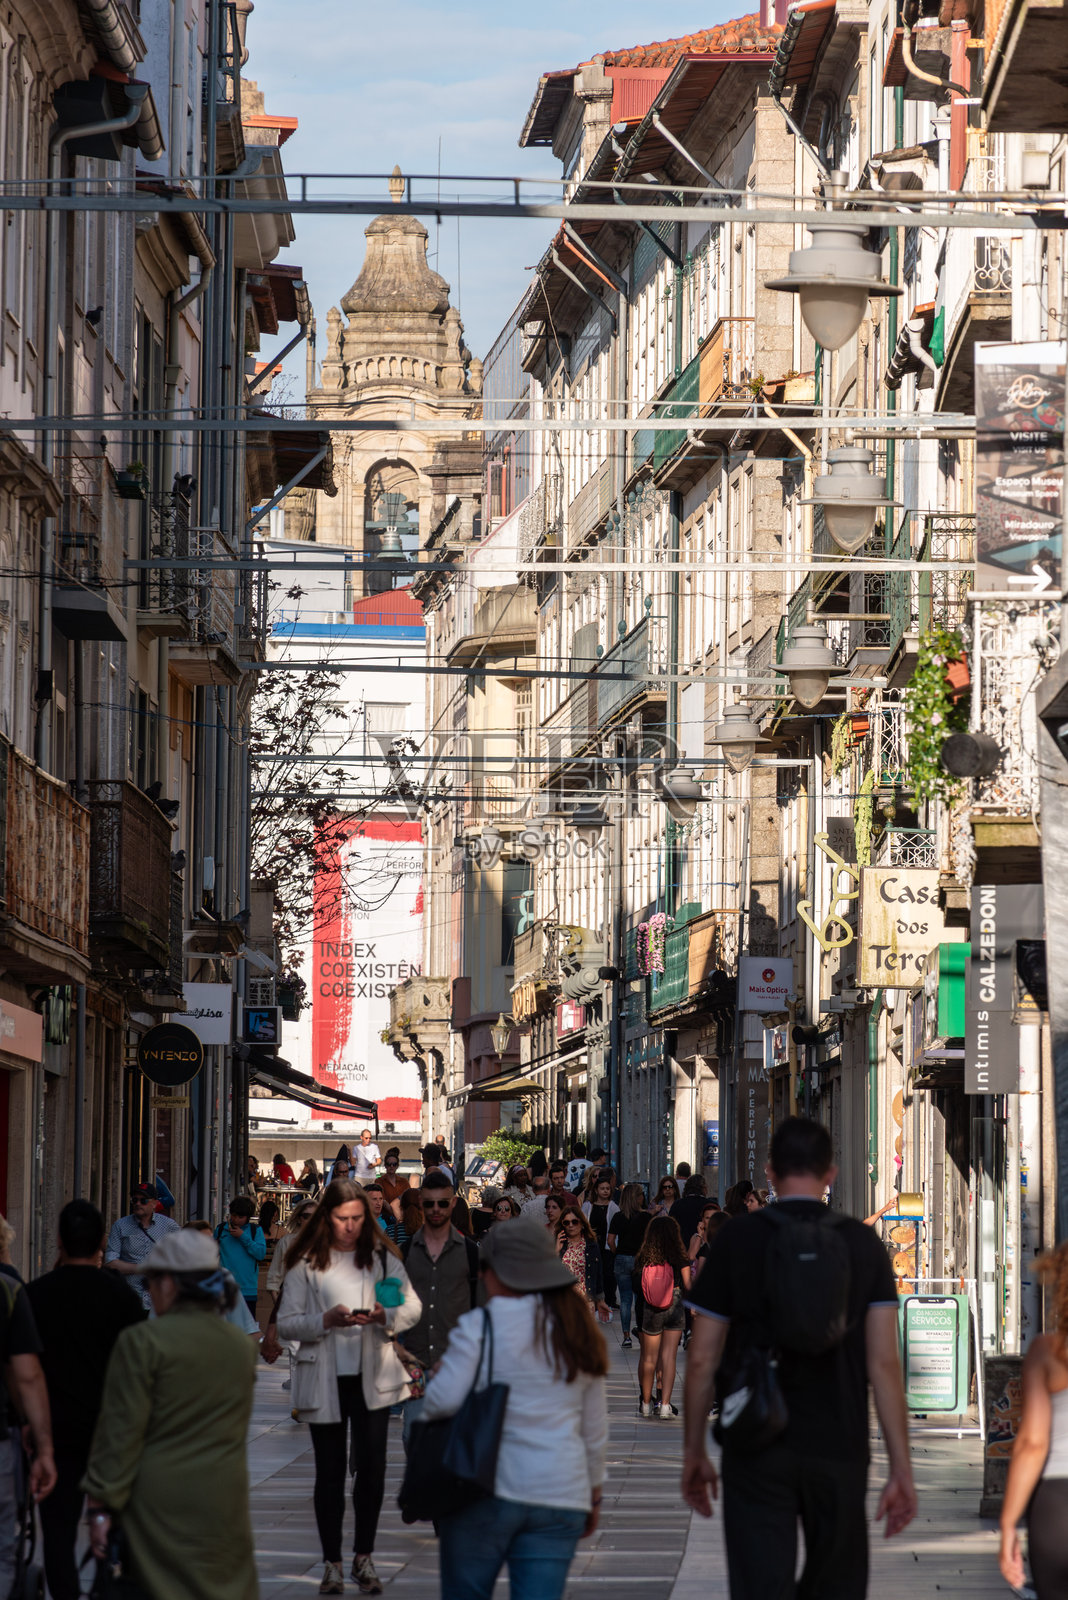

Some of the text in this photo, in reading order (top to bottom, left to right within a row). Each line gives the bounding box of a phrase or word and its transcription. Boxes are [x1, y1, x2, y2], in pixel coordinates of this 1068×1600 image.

[1009, 431, 1048, 442] VISITE
[1012, 446, 1047, 454] VISIT US
[995, 477, 1064, 487] Espaço Museu
[1035, 489, 1059, 498] Space
[1004, 520, 1055, 530] Miradouro
[1009, 533, 1050, 542] Viewpoint
[386, 861, 424, 870] PERFOR
[896, 918, 929, 935] dos
[320, 943, 377, 958] INDEX
[319, 959, 422, 979] COEXISTÊN
[319, 982, 400, 998] COEXIST
[748, 985, 789, 995] Mais Optica
[143, 1050, 198, 1062] YNTENZO
[318, 1063, 365, 1072] MEDIAÇÃO
[318, 1072, 368, 1081] EDUCATION
[748, 1088, 756, 1188] PERFUMARI
[911, 1316, 952, 1326] SERVIÇOS
